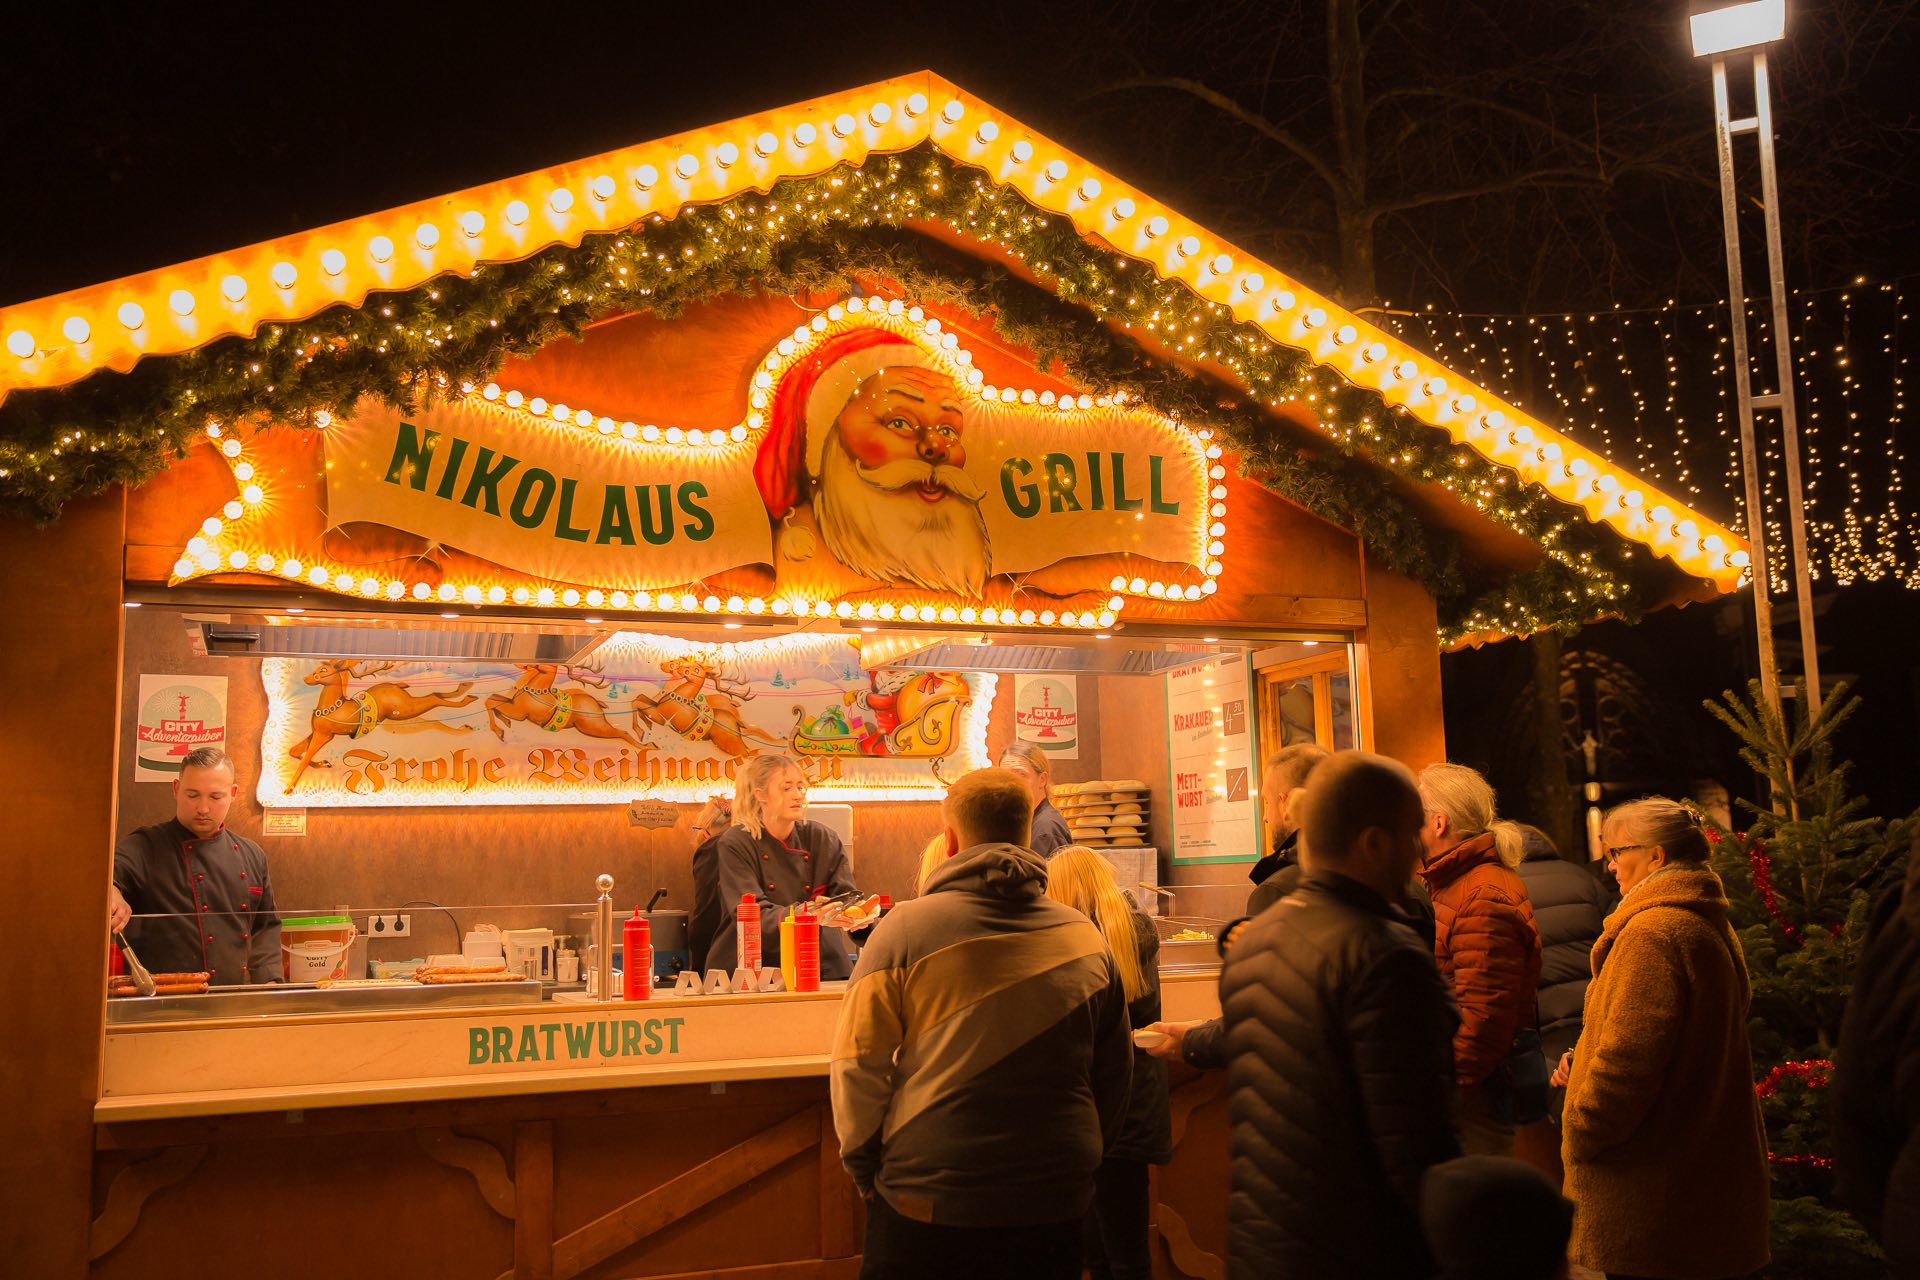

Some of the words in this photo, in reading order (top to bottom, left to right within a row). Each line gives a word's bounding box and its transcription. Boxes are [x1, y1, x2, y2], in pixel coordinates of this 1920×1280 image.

[384, 421, 715, 546] NIKOLAUS
[1000, 451, 1180, 519] GRILL
[1172, 661, 1216, 679] BRATWU
[1019, 713, 1075, 727] Adventszauber
[1034, 708, 1059, 717] CITY
[1174, 709, 1214, 732] KRAKAUER
[141, 728, 223, 743] Adventszauber
[164, 721, 200, 732] CITY
[342, 748, 507, 795] Frohe
[527, 748, 843, 790] Weihnacen
[1176, 772, 1203, 791] METT-
[1177, 790, 1203, 809] WURST
[468, 1017, 685, 1065] BRATWURST
